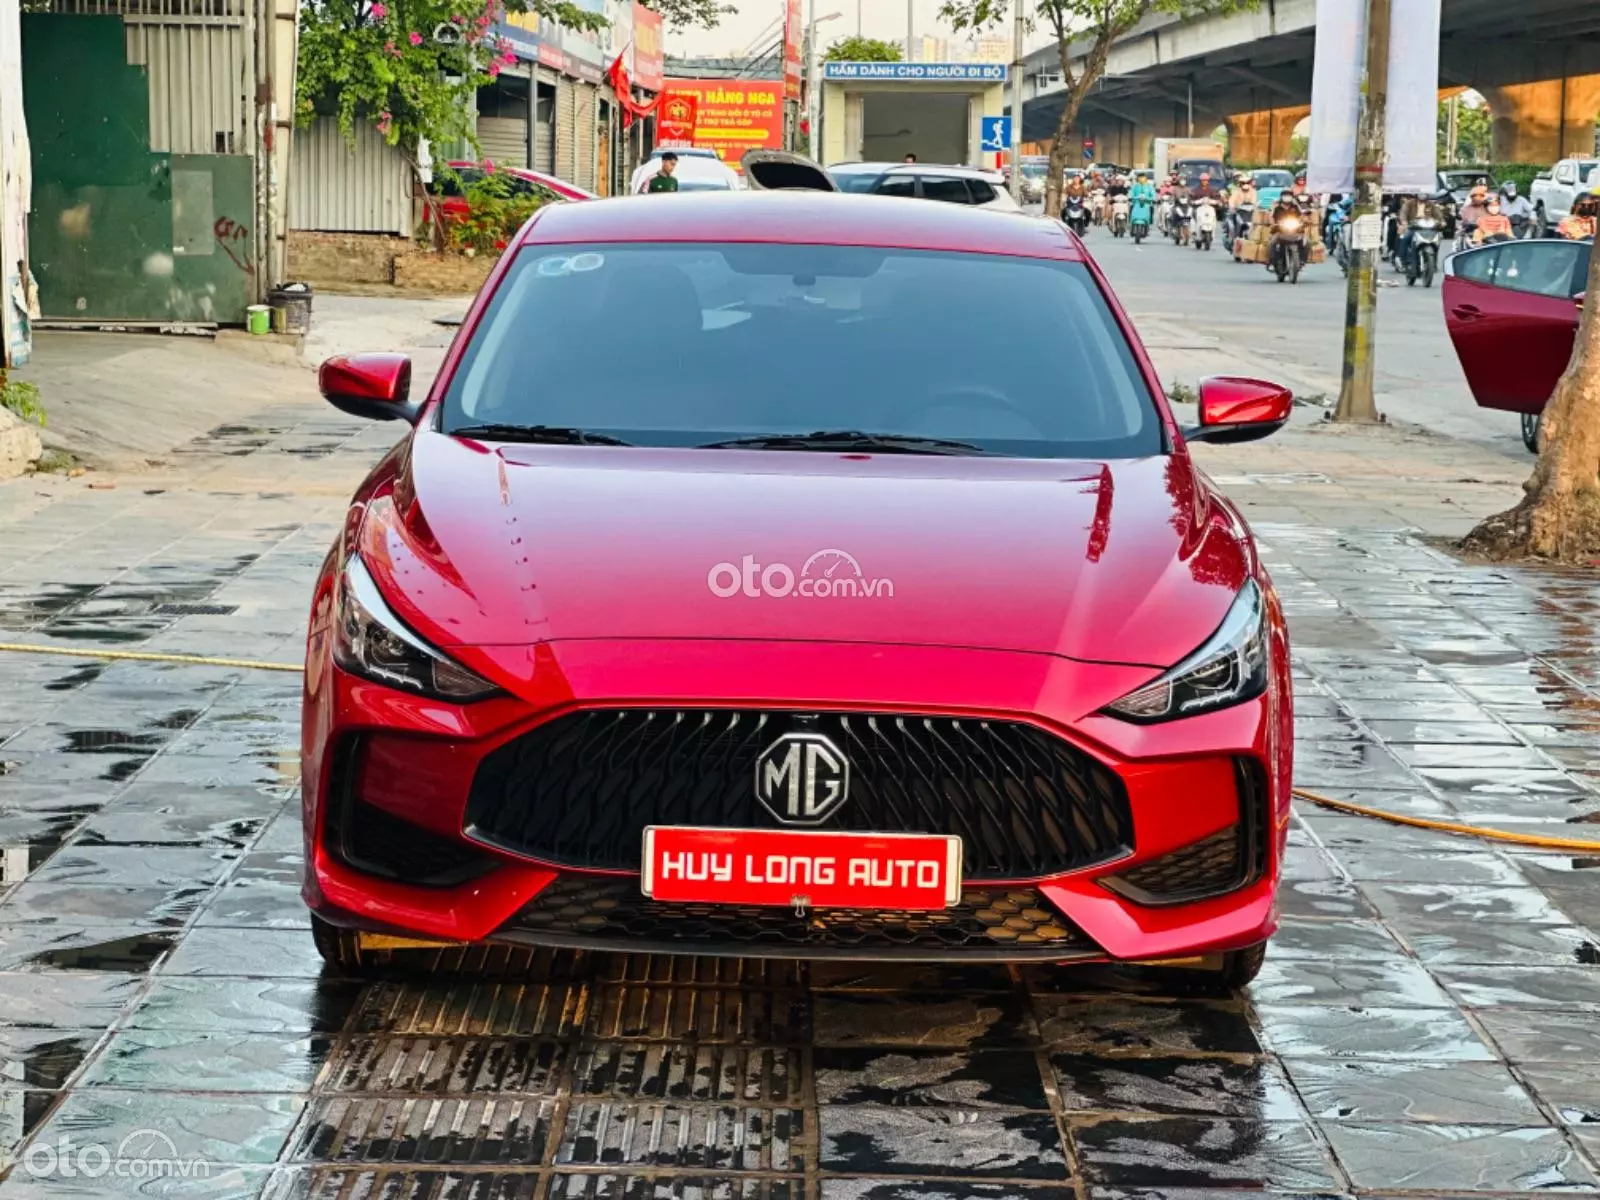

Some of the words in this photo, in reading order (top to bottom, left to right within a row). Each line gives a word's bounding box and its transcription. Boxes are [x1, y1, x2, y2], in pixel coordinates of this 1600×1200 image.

[860, 64, 895, 76] DÀNH
[898, 66, 925, 77] CHO
[926, 64, 966, 77] NGƯỜI
[968, 66, 981, 77] ĐI
[983, 65, 1002, 78] BỘ
[747, 91, 776, 105] NGA
[764, 742, 840, 816] MG
[661, 851, 733, 882] HUY
[745, 854, 836, 886] LONG
[848, 858, 939, 888] AUTO
